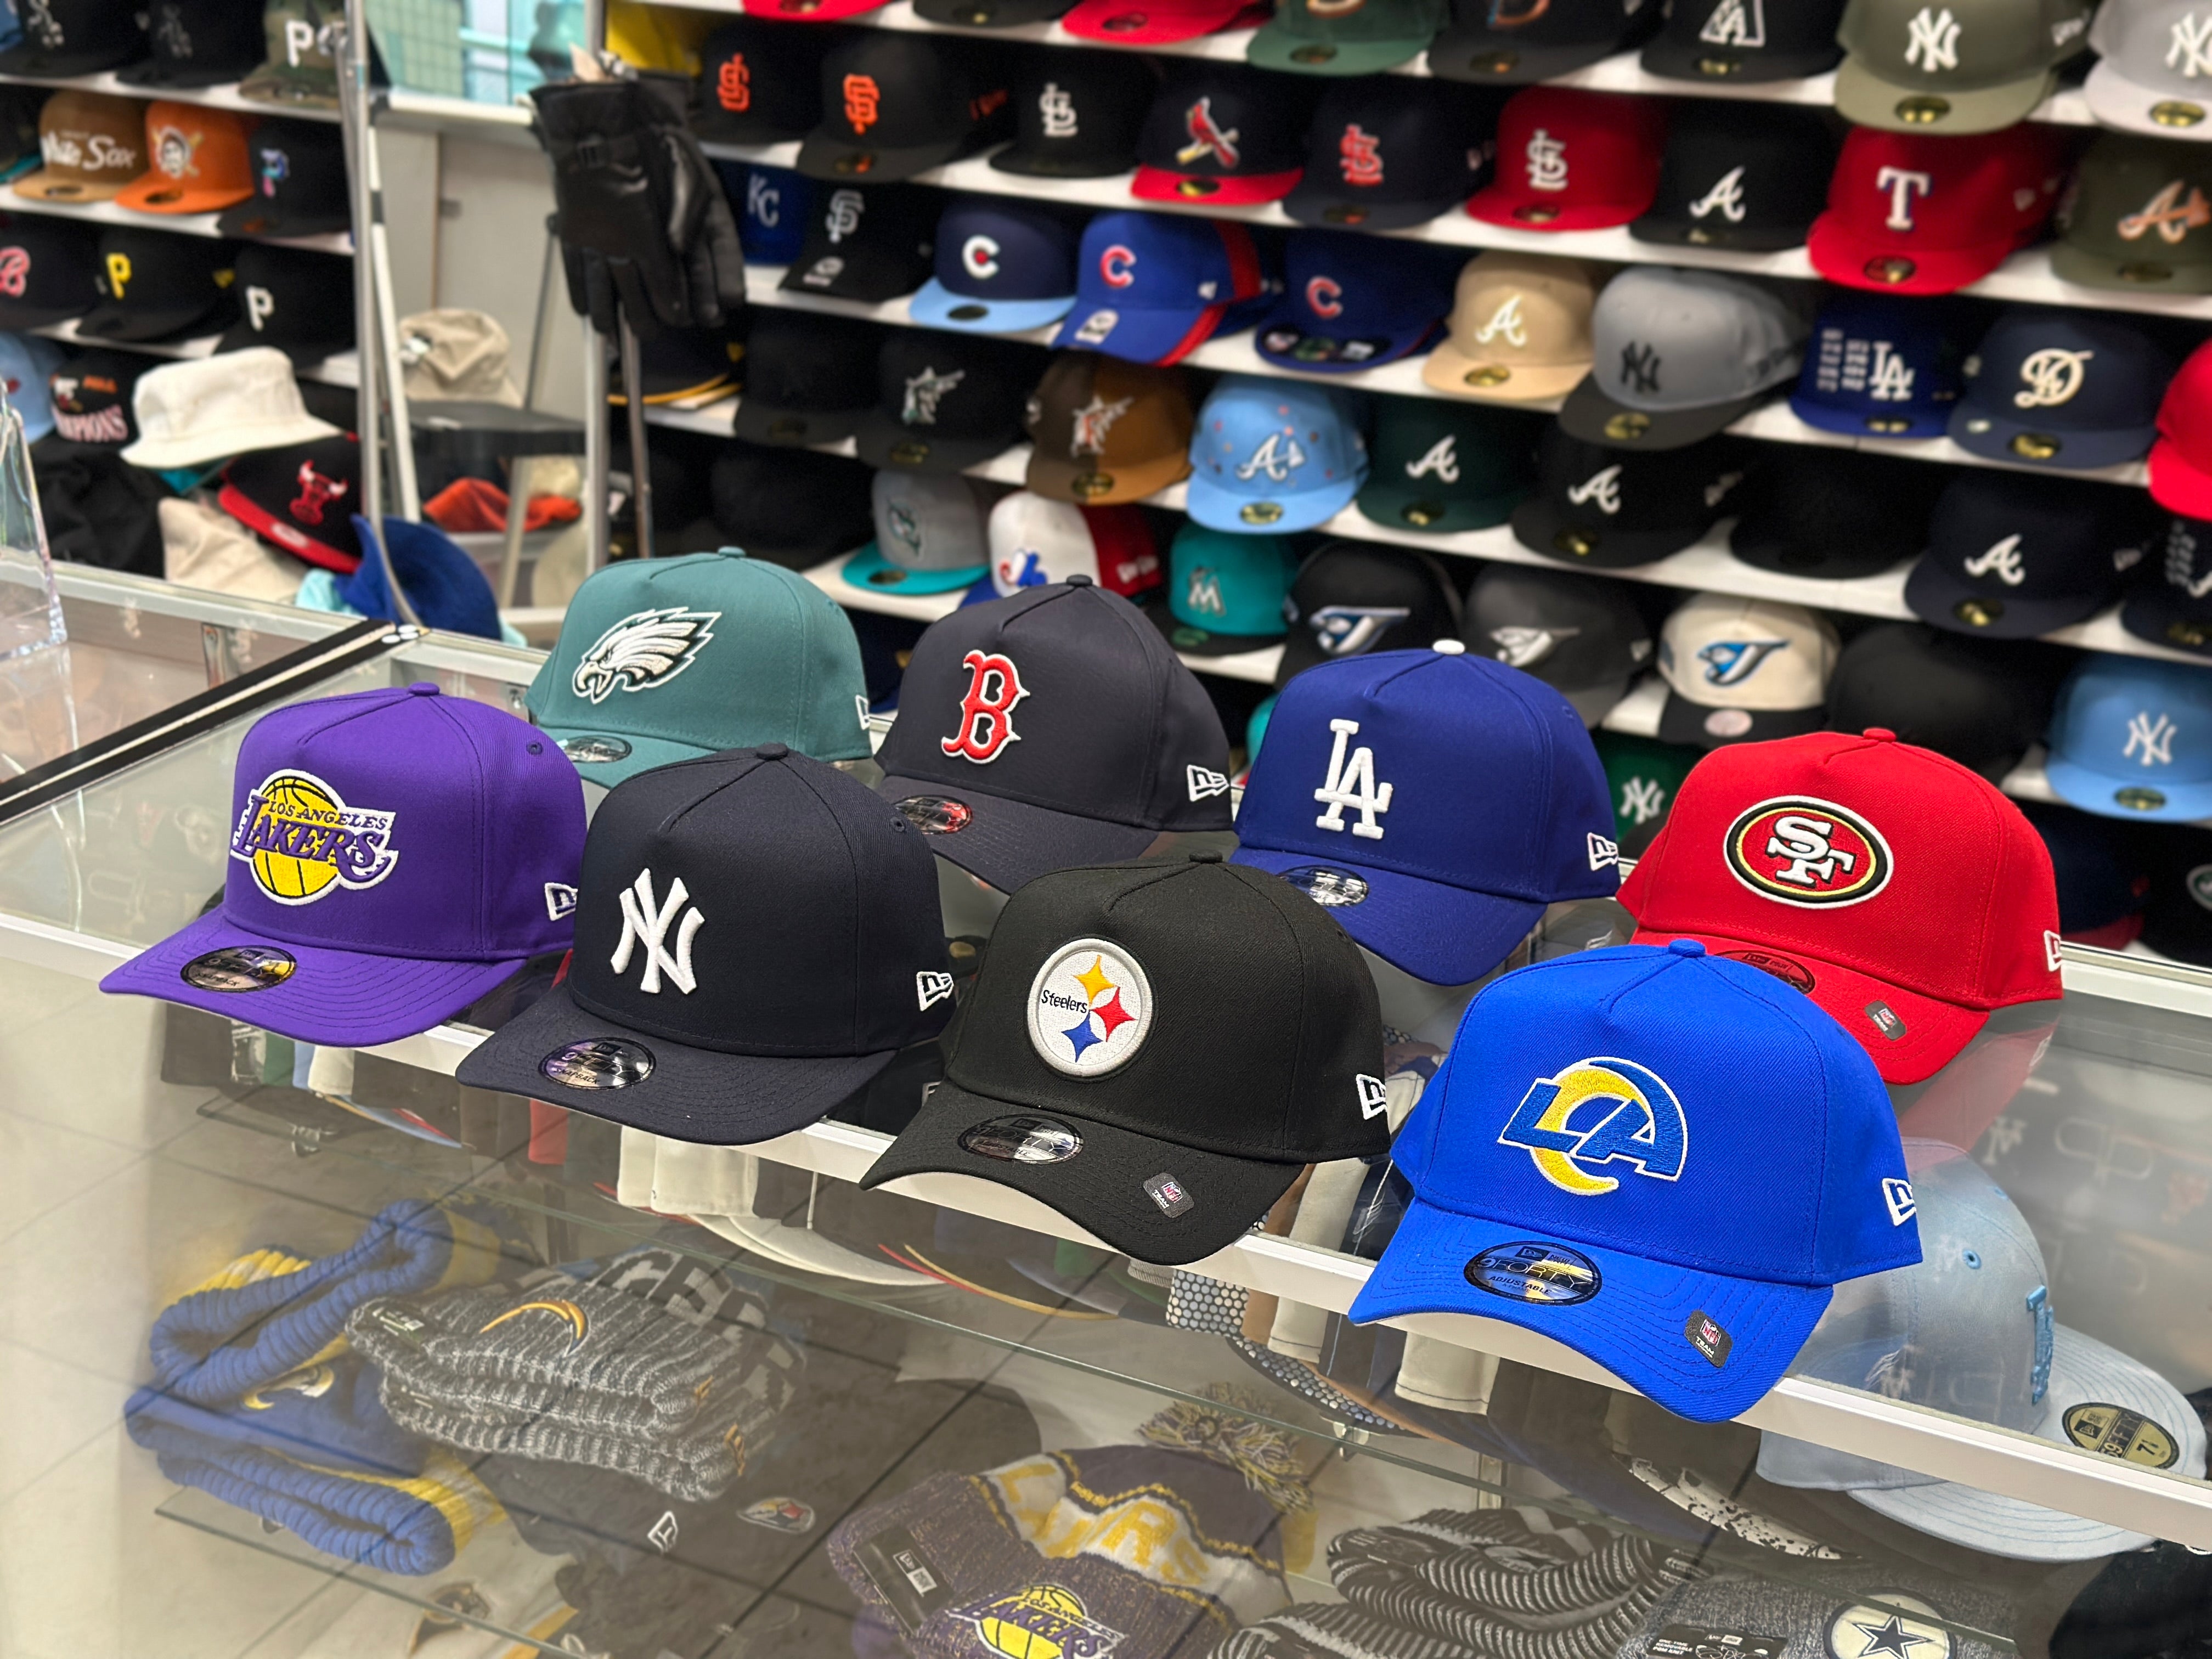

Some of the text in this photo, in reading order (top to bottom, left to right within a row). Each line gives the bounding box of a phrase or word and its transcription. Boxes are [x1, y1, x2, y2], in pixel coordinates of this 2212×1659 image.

[1905, 8, 1962, 71] NY
[747, 173, 780, 228] KC
[1689, 166, 1746, 221] A
[1876, 166, 1930, 231] T
[106, 253, 132, 298] P
[962, 235, 1000, 278] C
[1101, 245, 1136, 288] C
[246, 286, 274, 331] P
[1307, 276, 1342, 318] C
[1476, 295, 1527, 347] A
[1870, 341, 1915, 401] LA
[1406, 435, 1460, 483] A
[1568, 465, 1622, 515] A
[1964, 533, 2025, 585] A
[941, 650, 1030, 764] B
[2123, 711, 2178, 767] NY
[1314, 719, 1393, 840] LA
[231, 794, 392, 883] LAKERS
[268, 800, 388, 831] LOS ANGELES
[610, 867, 706, 995] NY
[1041, 989, 1088, 1013] Steelers
[1477, 1257, 1591, 1289] 9FORTY
[1488, 1275, 1553, 1295] ADJUSTABLE
